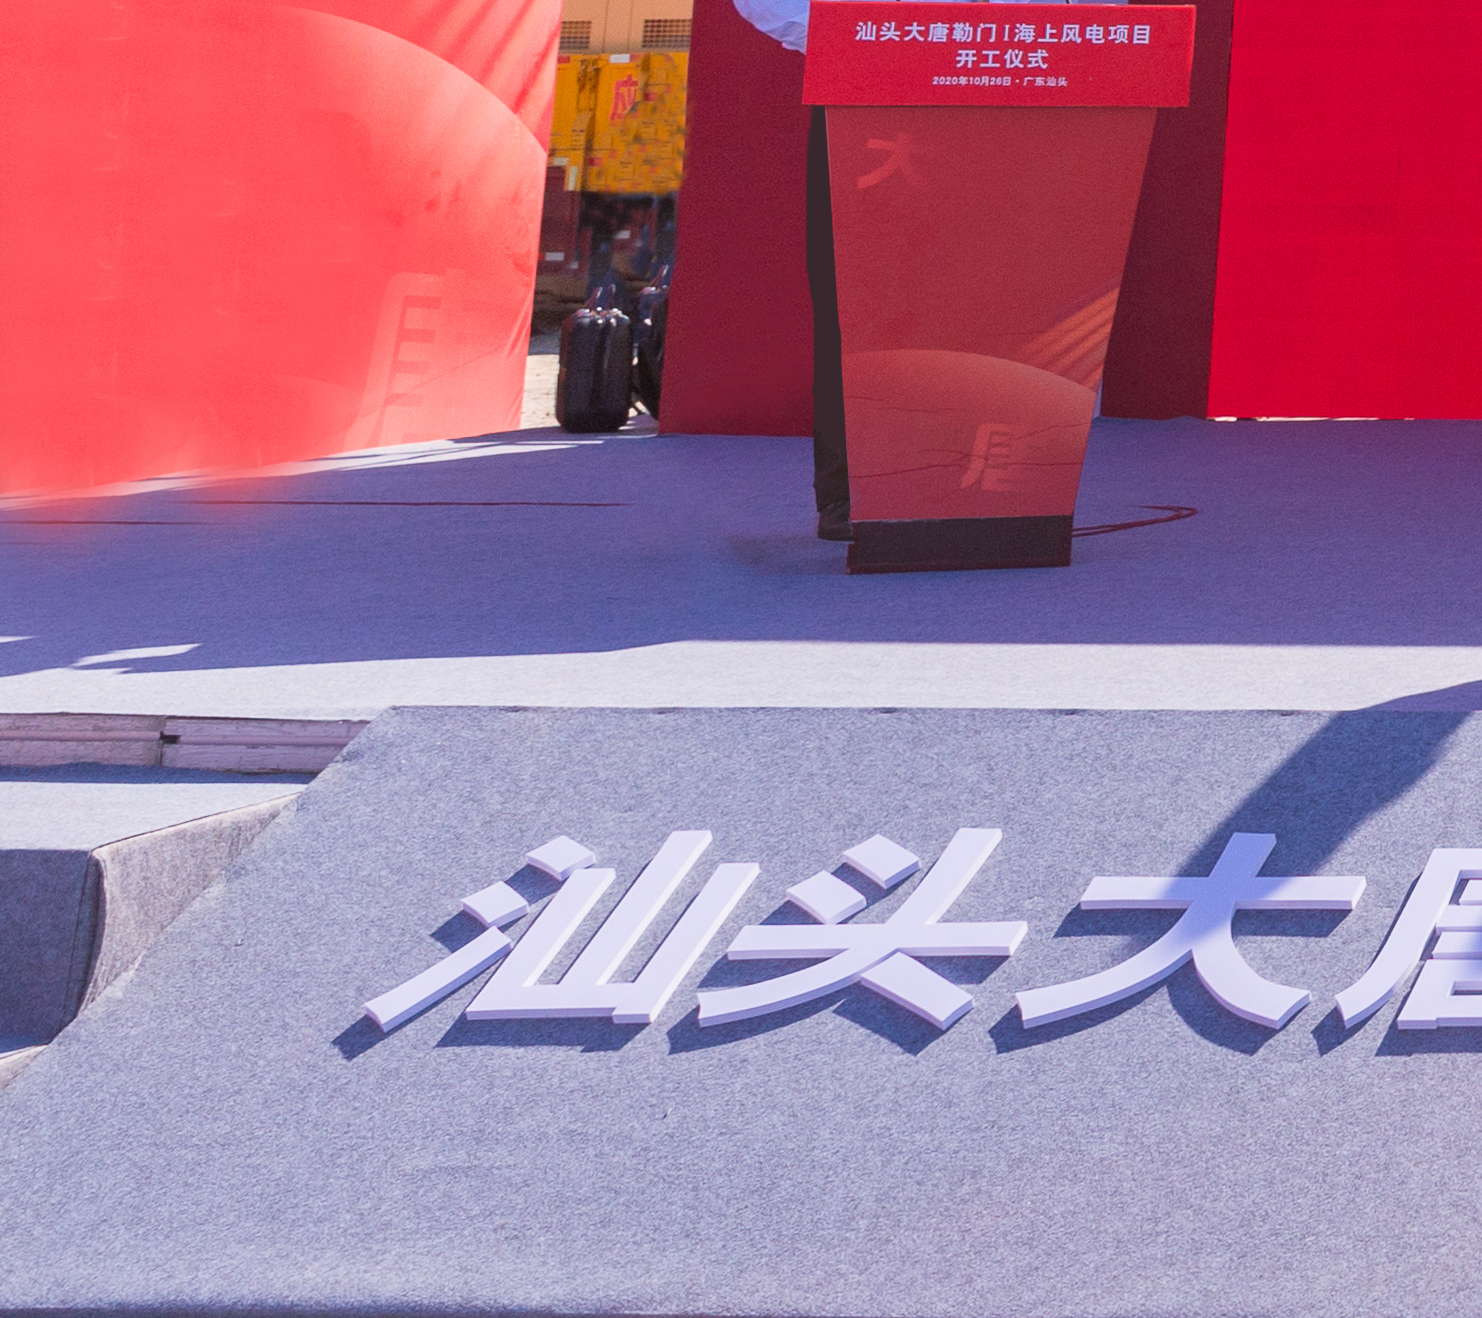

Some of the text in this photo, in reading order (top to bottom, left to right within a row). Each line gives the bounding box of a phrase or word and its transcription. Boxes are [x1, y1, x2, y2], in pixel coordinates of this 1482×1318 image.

[855, 21, 1152, 46] 汕头大唐勒门I海上风电项目
[955, 48, 1050, 69] 开工仪式
